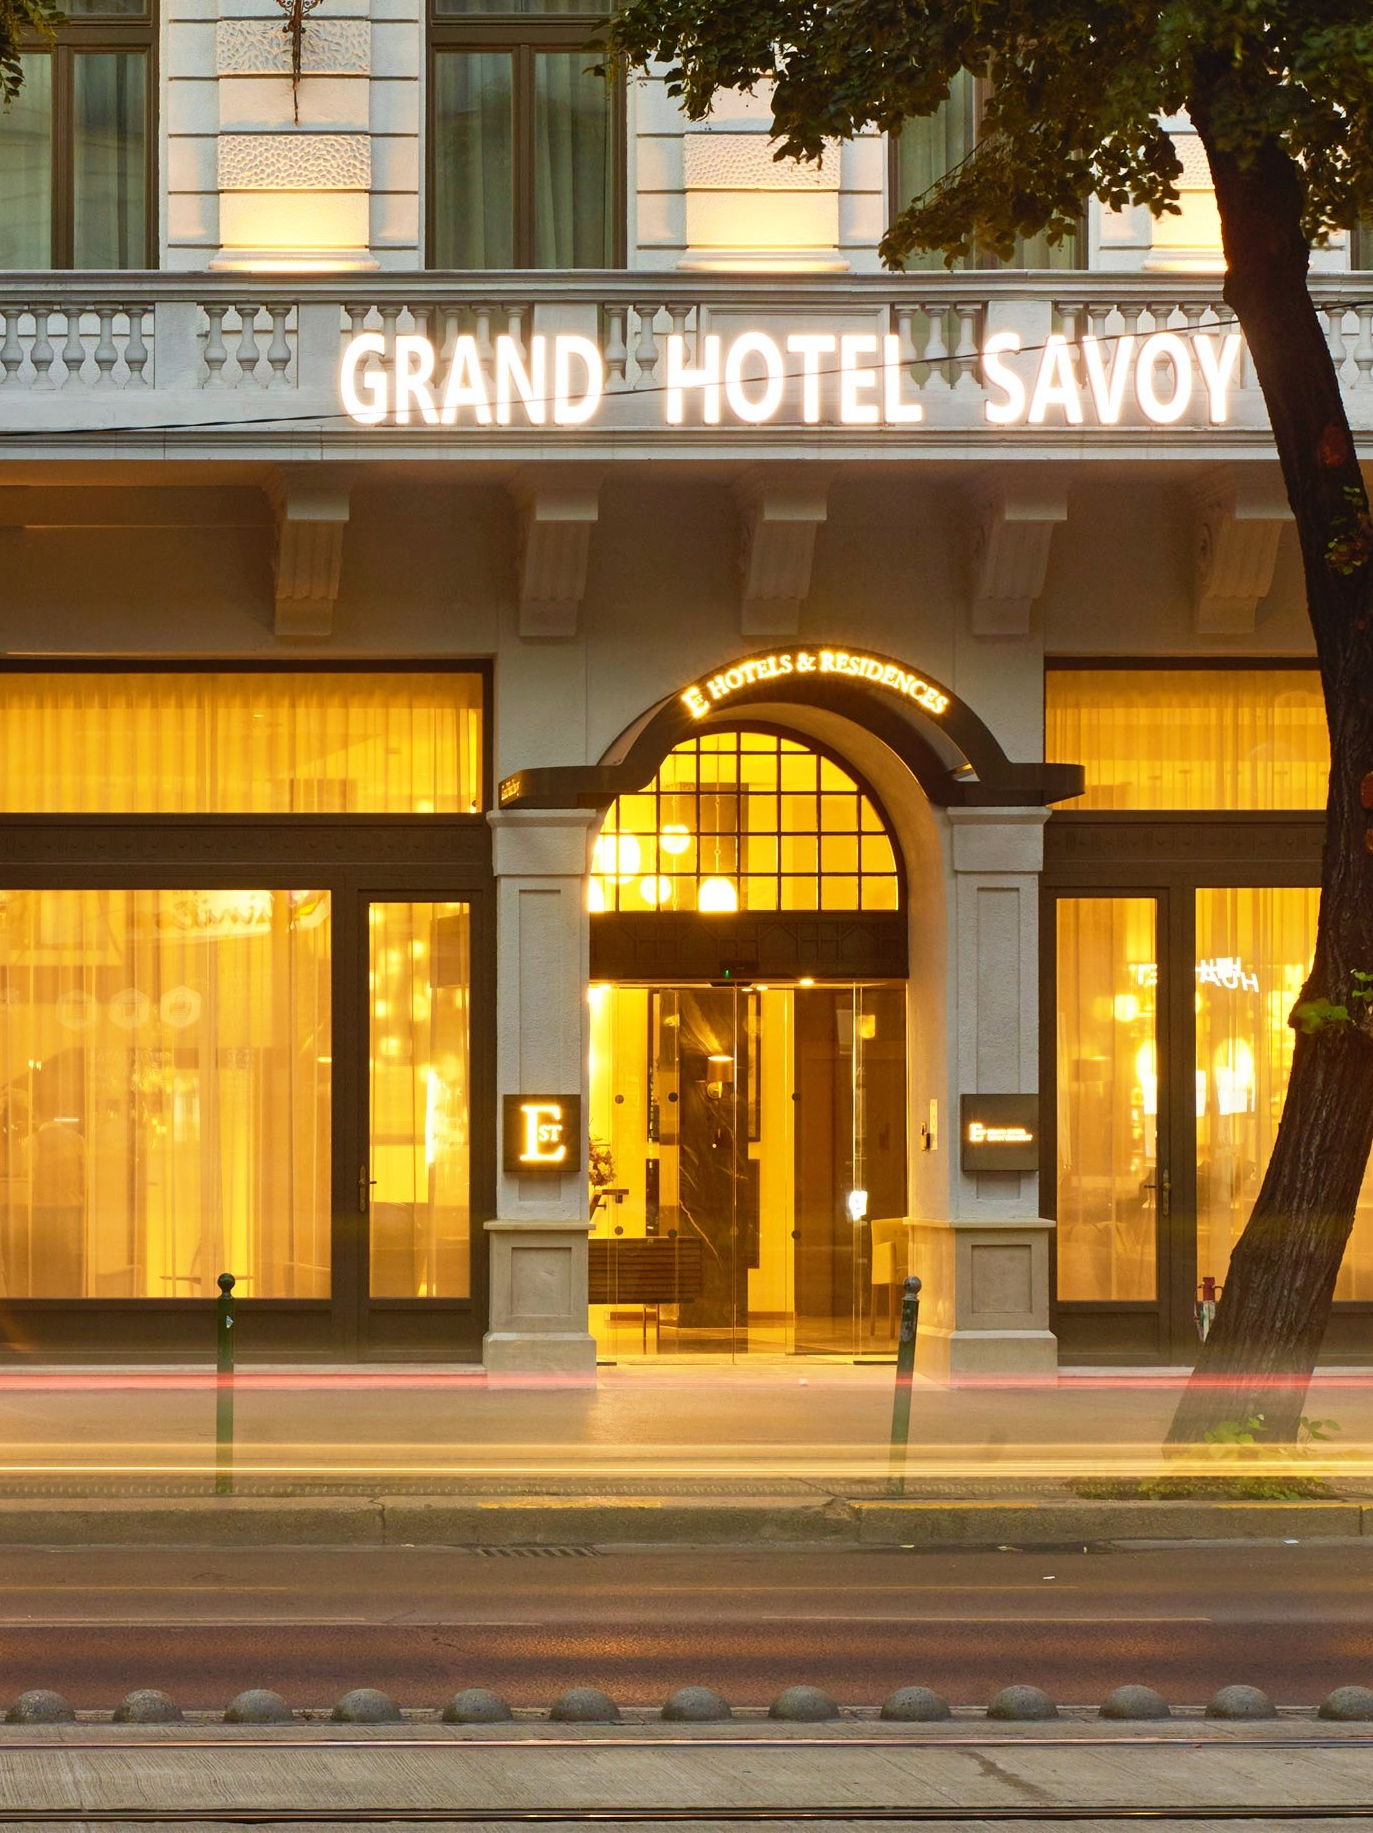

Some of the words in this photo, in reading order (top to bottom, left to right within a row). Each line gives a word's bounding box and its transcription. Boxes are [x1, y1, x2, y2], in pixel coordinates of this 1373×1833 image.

[340, 332, 604, 425] GRAND
[666, 331, 923, 424] HOTEL
[981, 332, 1243, 424] SAVOY
[706, 653, 794, 700] HOTELS
[796, 651, 817, 673] &
[819, 650, 950, 715] RESIDENCES
